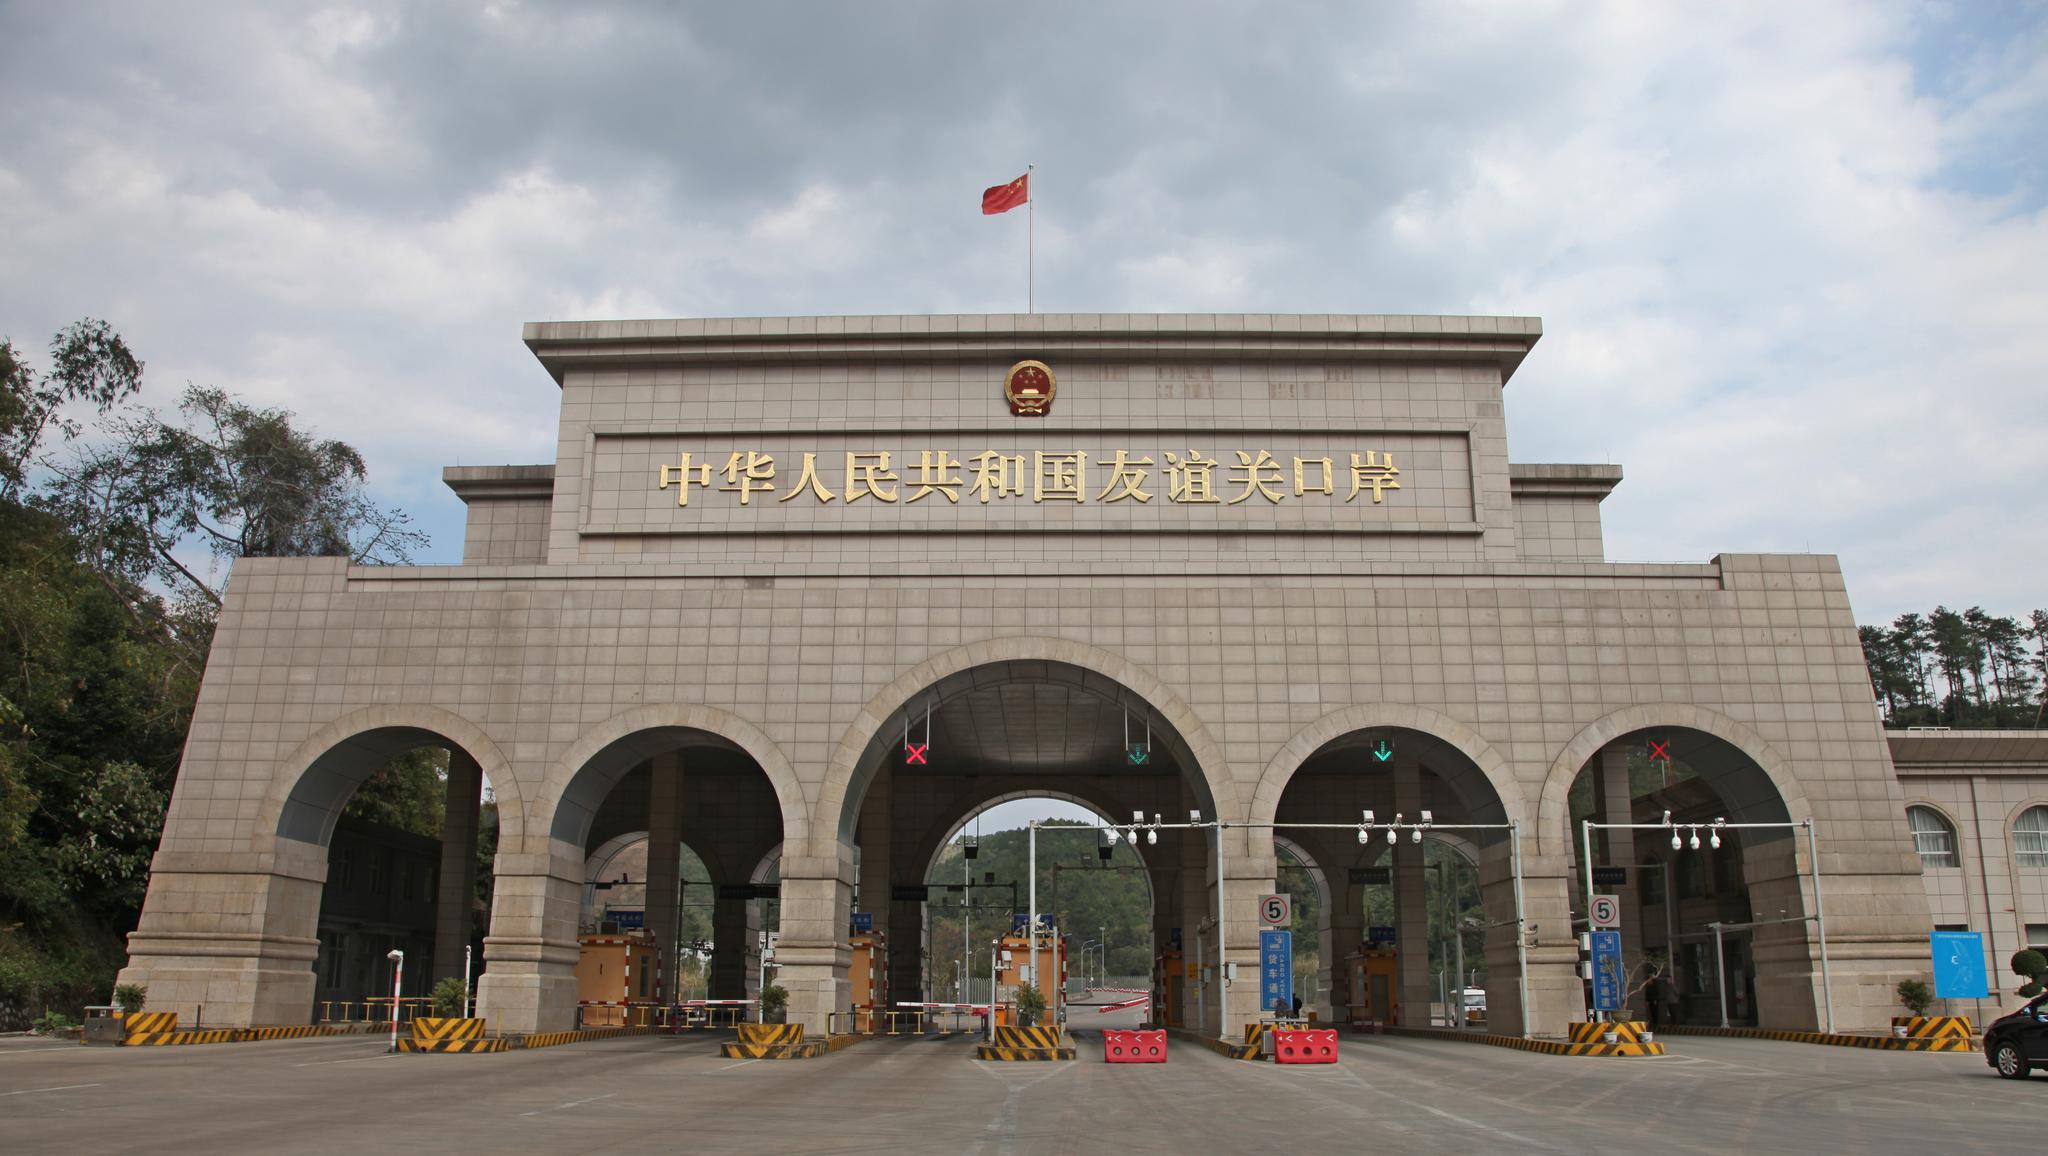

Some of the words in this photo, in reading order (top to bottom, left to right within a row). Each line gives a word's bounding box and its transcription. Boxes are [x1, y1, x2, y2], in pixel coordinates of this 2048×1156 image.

[659, 449, 1401, 506] 中华人民共和国友谊关口岸
[1268, 901, 1281, 919] 5
[1597, 902, 1610, 920] 5
